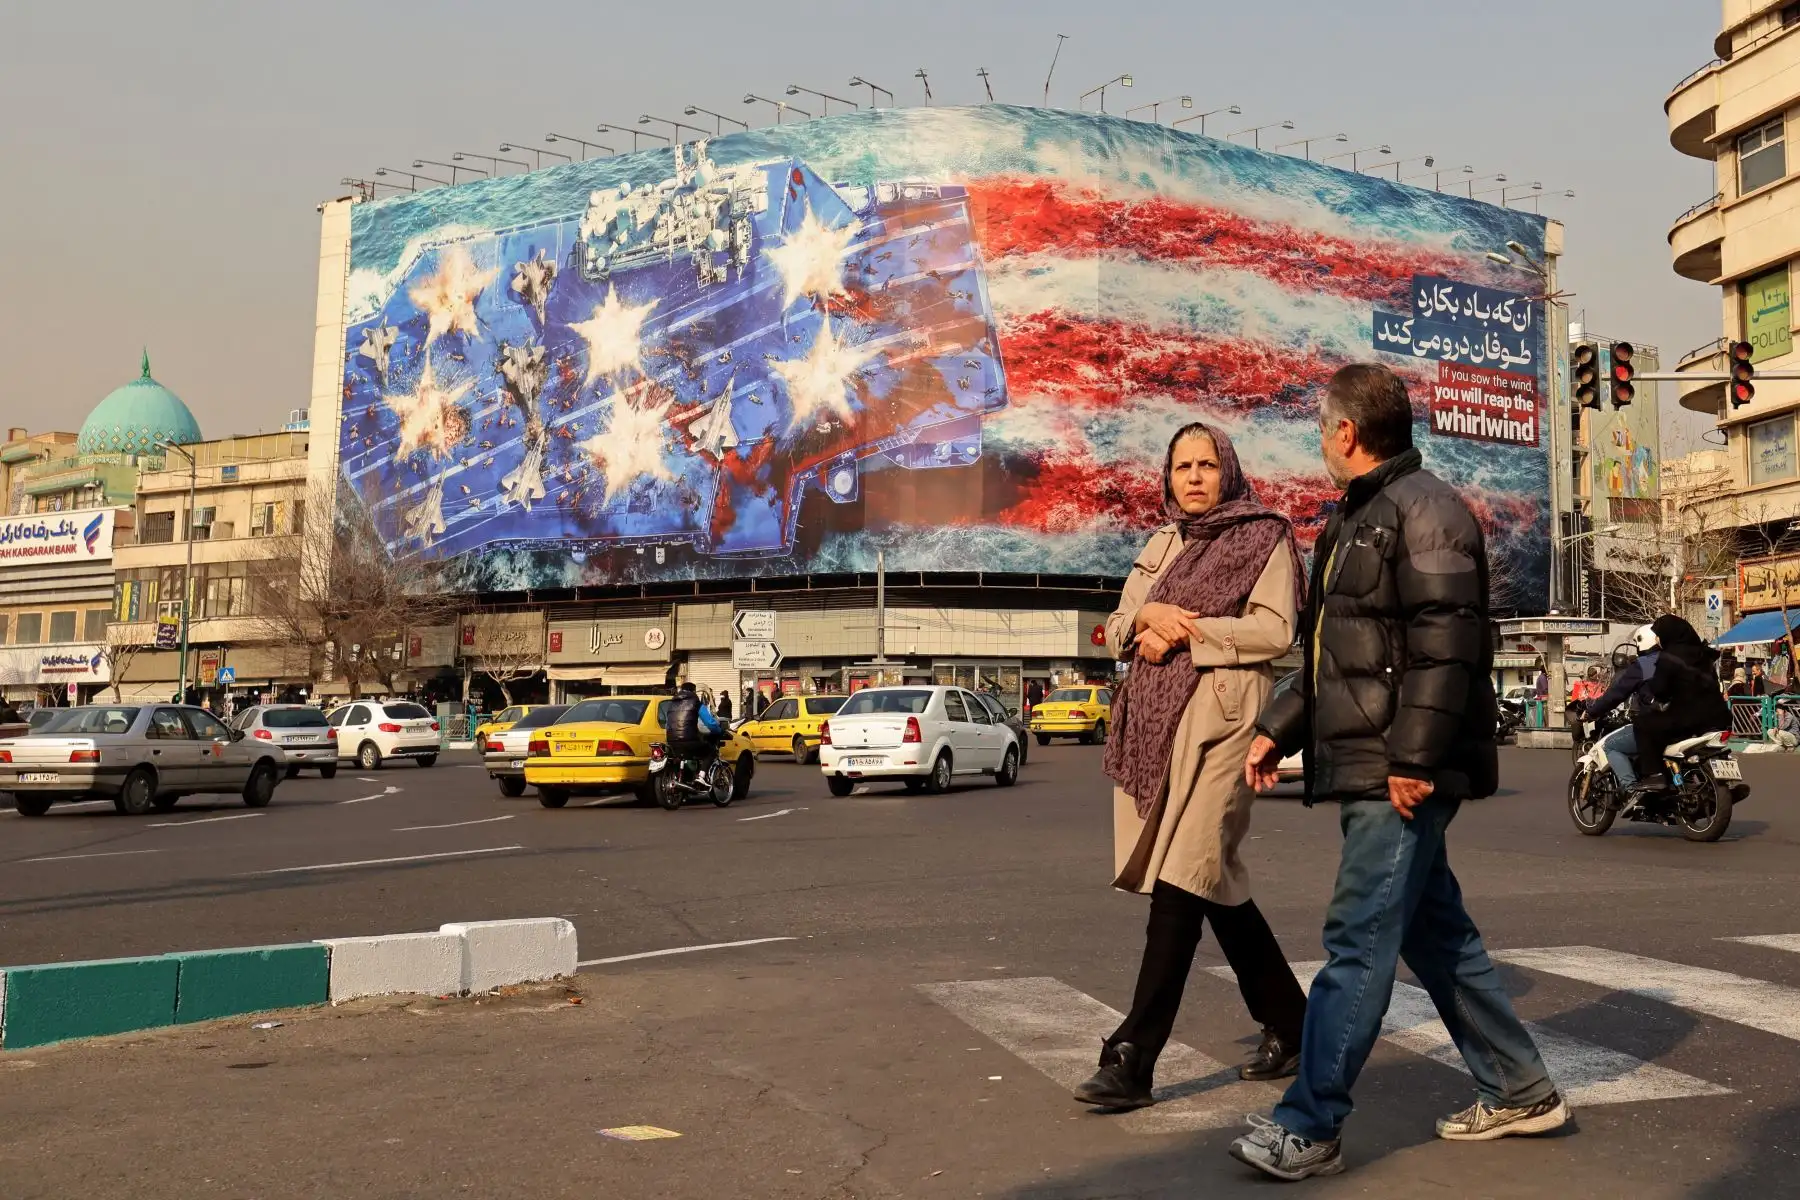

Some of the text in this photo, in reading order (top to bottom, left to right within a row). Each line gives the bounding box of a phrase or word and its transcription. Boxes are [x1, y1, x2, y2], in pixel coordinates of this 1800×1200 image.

[1417, 283, 1459, 321] بکارد
[1463, 291, 1490, 327] باد
[1512, 296, 1533, 333] آن
[1440, 335, 1470, 361] درو
[1752, 325, 1792, 348] POLICE
[1470, 331, 1532, 370] طوفان
[1441, 366, 1534, 394] If you sow the wind,
[1434, 385, 1534, 412] you will reap the
[1434, 405, 1534, 441] whirlwind
[23, 520, 49, 541] رفاه
[50, 519, 78, 540] بانک
[12, 544, 54, 558] KARGARAN
[55, 544, 77, 555] BANK
[1544, 622, 1571, 630] POLICE
[603, 634, 623, 647] کفش
